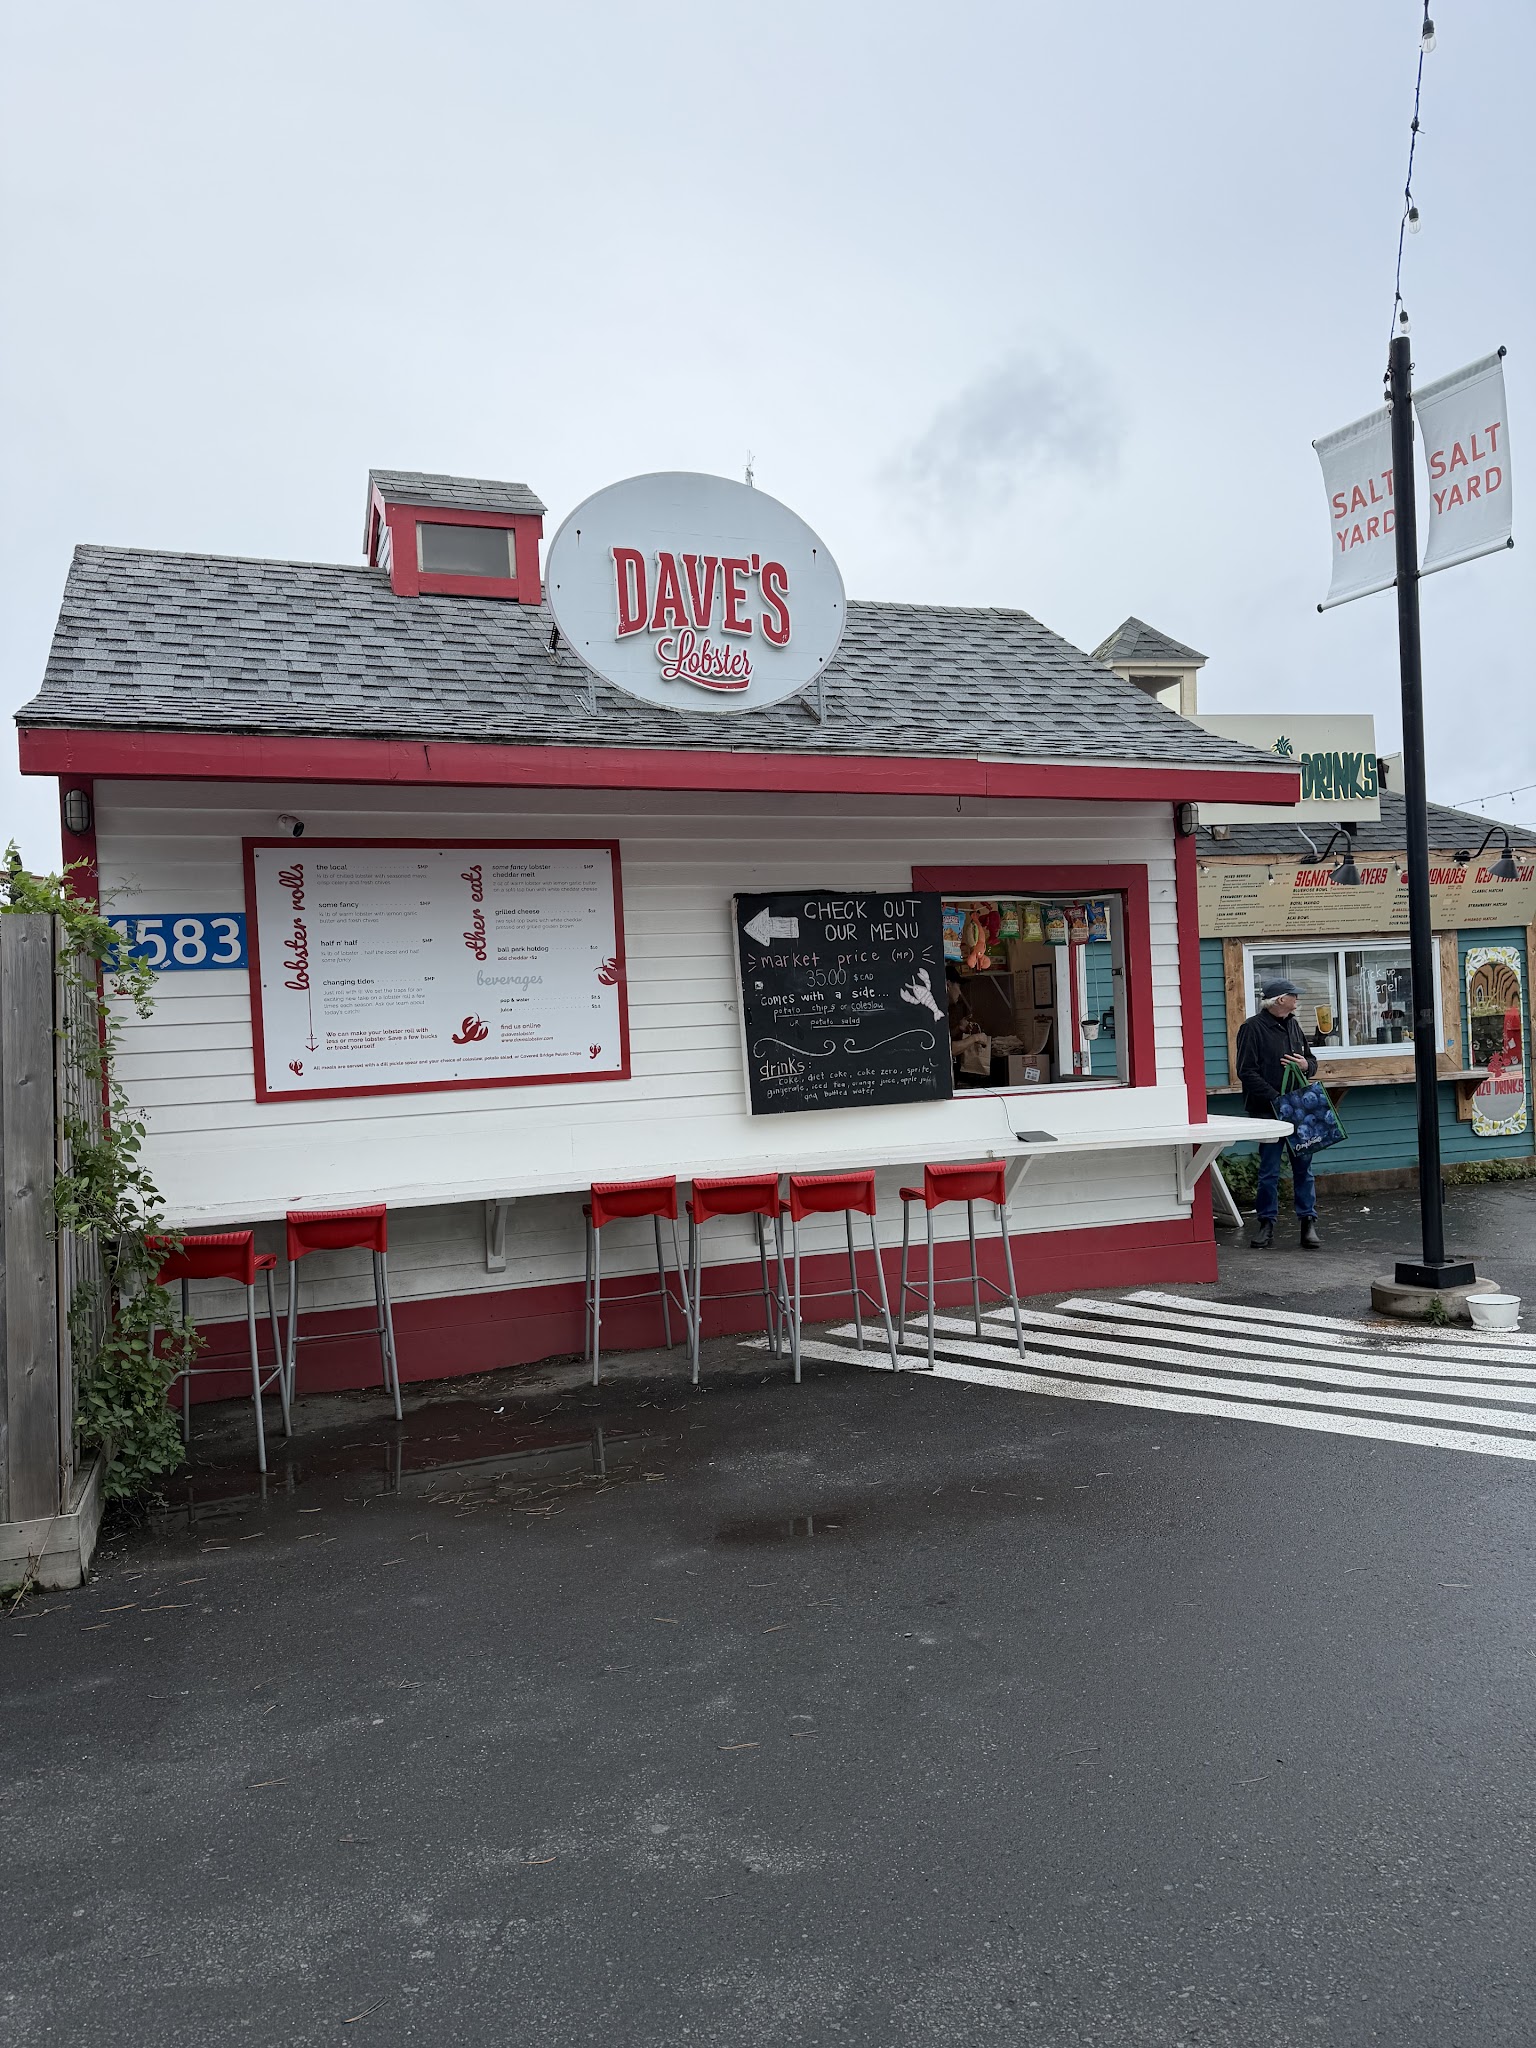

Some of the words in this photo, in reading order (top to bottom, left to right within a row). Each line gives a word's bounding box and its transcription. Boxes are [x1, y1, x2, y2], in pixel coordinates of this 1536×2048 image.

[1430, 422, 1501, 480] SALT
[1332, 468, 1394, 519] SALT
[1432, 466, 1502, 515] YARD
[1336, 509, 1396, 552] YARD
[609, 546, 791, 648] DAVE'S
[655, 628, 754, 683] Lobster
[1300, 752, 1378, 800] DRINKS
[278, 863, 305, 911] rolls
[461, 864, 483, 903] eats
[1294, 869, 1345, 887] SIGNAT
[1360, 868, 1388, 885] AYERS
[1429, 867, 1467, 885] ONADES
[340, 901, 358, 909] fancy
[804, 901, 868, 921] CHECK
[883, 899, 921, 918] OUT
[109, 917, 242, 966] 1583
[463, 908, 487, 961] other
[825, 923, 858, 942] OUR
[870, 922, 919, 942] MENU
[283, 918, 310, 991] lobster
[760, 952, 820, 969] market
[837, 949, 880, 971] price
[891, 948, 915, 963] (MP)
[476, 969, 543, 992] beverages
[805, 968, 847, 988] 35.00
[800, 991, 824, 1002] with
[835, 991, 842, 1000] a
[773, 1007, 800, 1023] potato
[851, 1000, 884, 1010] coleslaw
[810, 1017, 834, 1030] potato
[841, 1017, 860, 1025] salad
[808, 1072, 824, 1081] diet
[857, 1068, 875, 1076] coke
[812, 1082, 827, 1090] iced
[852, 1080, 875, 1088] orange
[900, 1076, 917, 1085] apple
[804, 1093, 818, 1102] and
[852, 1088, 875, 1096] water
[1495, 1078, 1524, 1095] DRINKS
